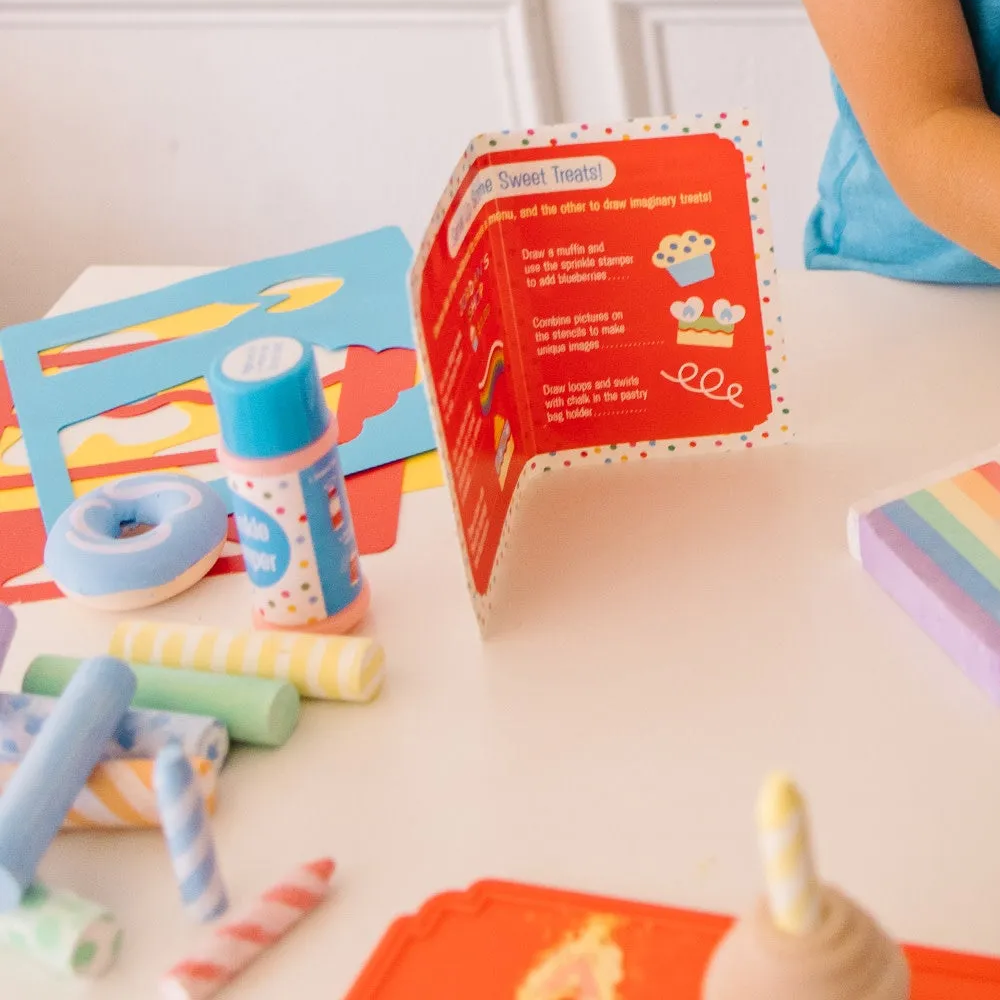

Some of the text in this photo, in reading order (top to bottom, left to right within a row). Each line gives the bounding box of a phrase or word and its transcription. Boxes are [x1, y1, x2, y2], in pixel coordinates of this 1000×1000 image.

[499, 168, 547, 189] Sweet
[552, 163, 603, 184] Treats!
[520, 205, 538, 219] and
[541, 203, 557, 216] the
[560, 200, 586, 214] other
[589, 200, 600, 211] to
[603, 198, 627, 210] draw
[630, 193, 676, 210] imaginary
[680, 190, 713, 204] treats!
[521, 241, 605, 260] Draw a muffin and
[524, 256, 634, 274] use the sprinkle stamper
[526, 277, 536, 288] to
[539, 274, 556, 287] add
[532, 311, 624, 328] Combine pictures on
[535, 323, 625, 342] the stencils to make
[537, 343, 566, 356] unique
[543, 375, 640, 396] Draw loops and swirls
[544, 389, 648, 409] with chalk in the pastry
[546, 411, 564, 423] bag
